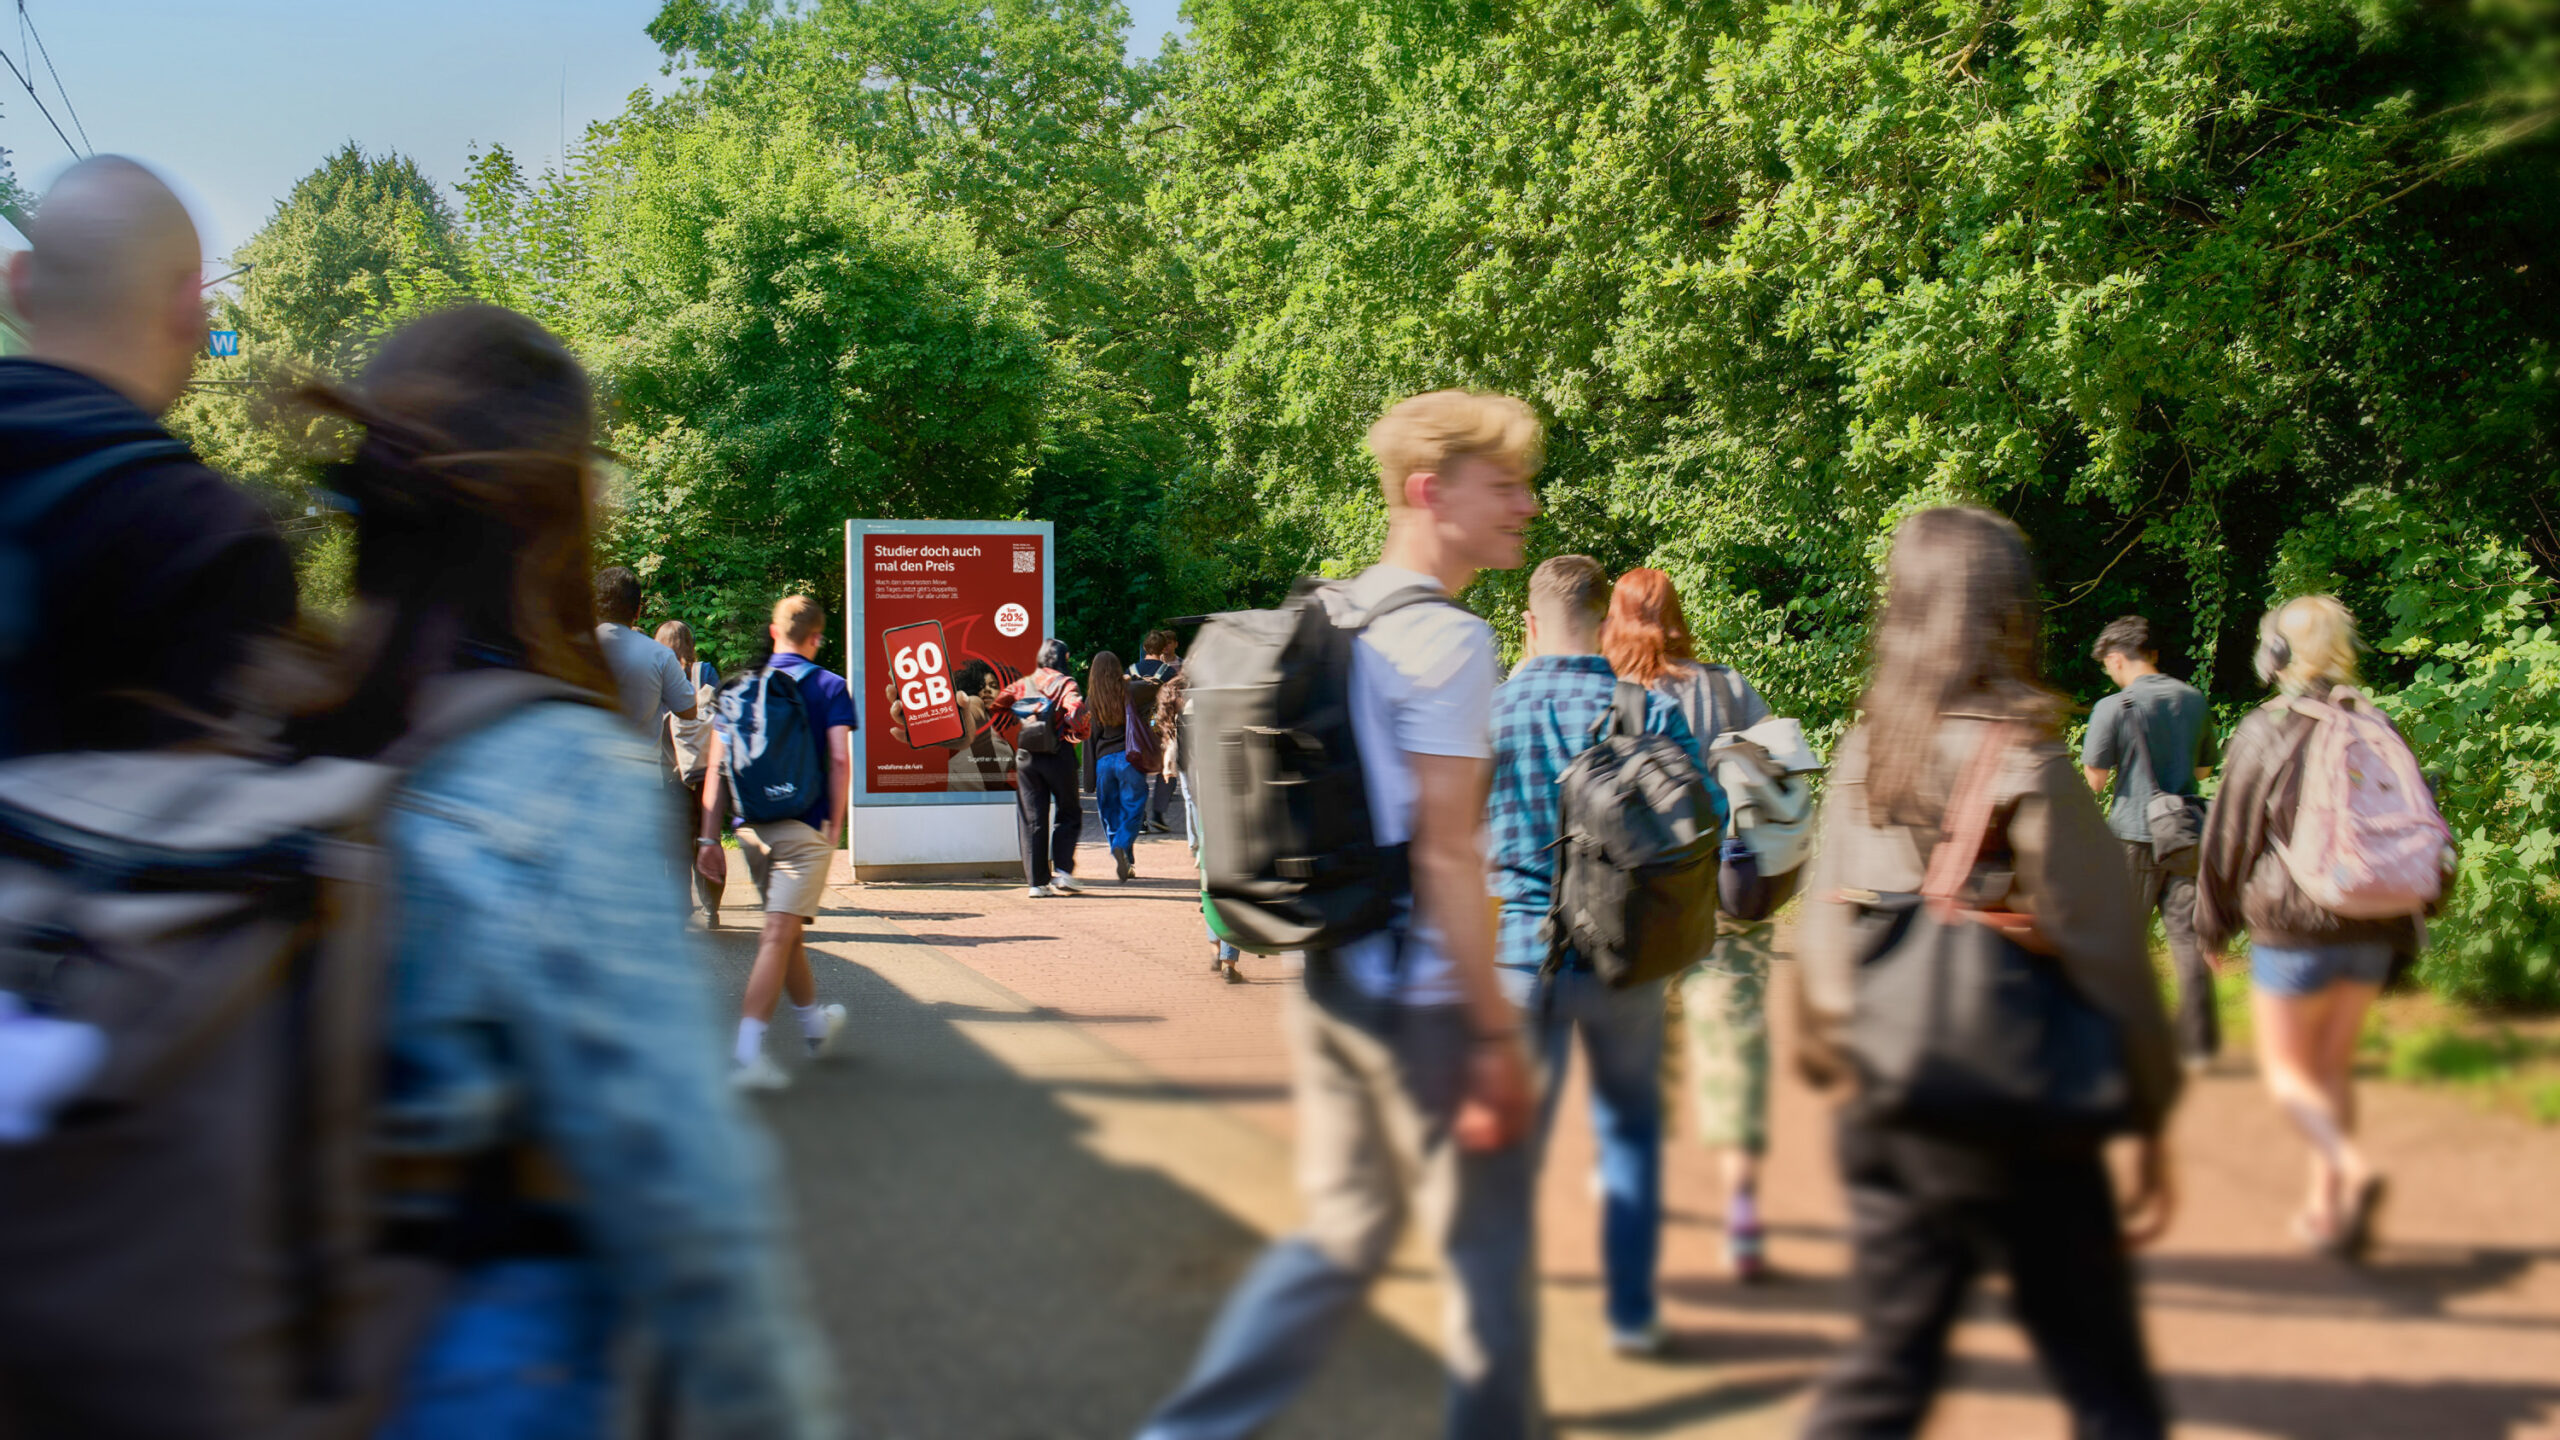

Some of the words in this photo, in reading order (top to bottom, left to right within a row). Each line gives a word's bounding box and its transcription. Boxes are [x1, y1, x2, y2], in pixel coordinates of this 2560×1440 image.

[212, 334, 235, 353] W
[874, 545, 918, 557] Studier
[920, 545, 949, 557] doch
[952, 545, 981, 557] auch
[874, 560, 898, 572] mal
[900, 560, 923, 572] den
[925, 560, 956, 572] Preis
[894, 641, 943, 680] 60
[901, 675, 952, 711] GB
[967, 755, 993, 763] Together
